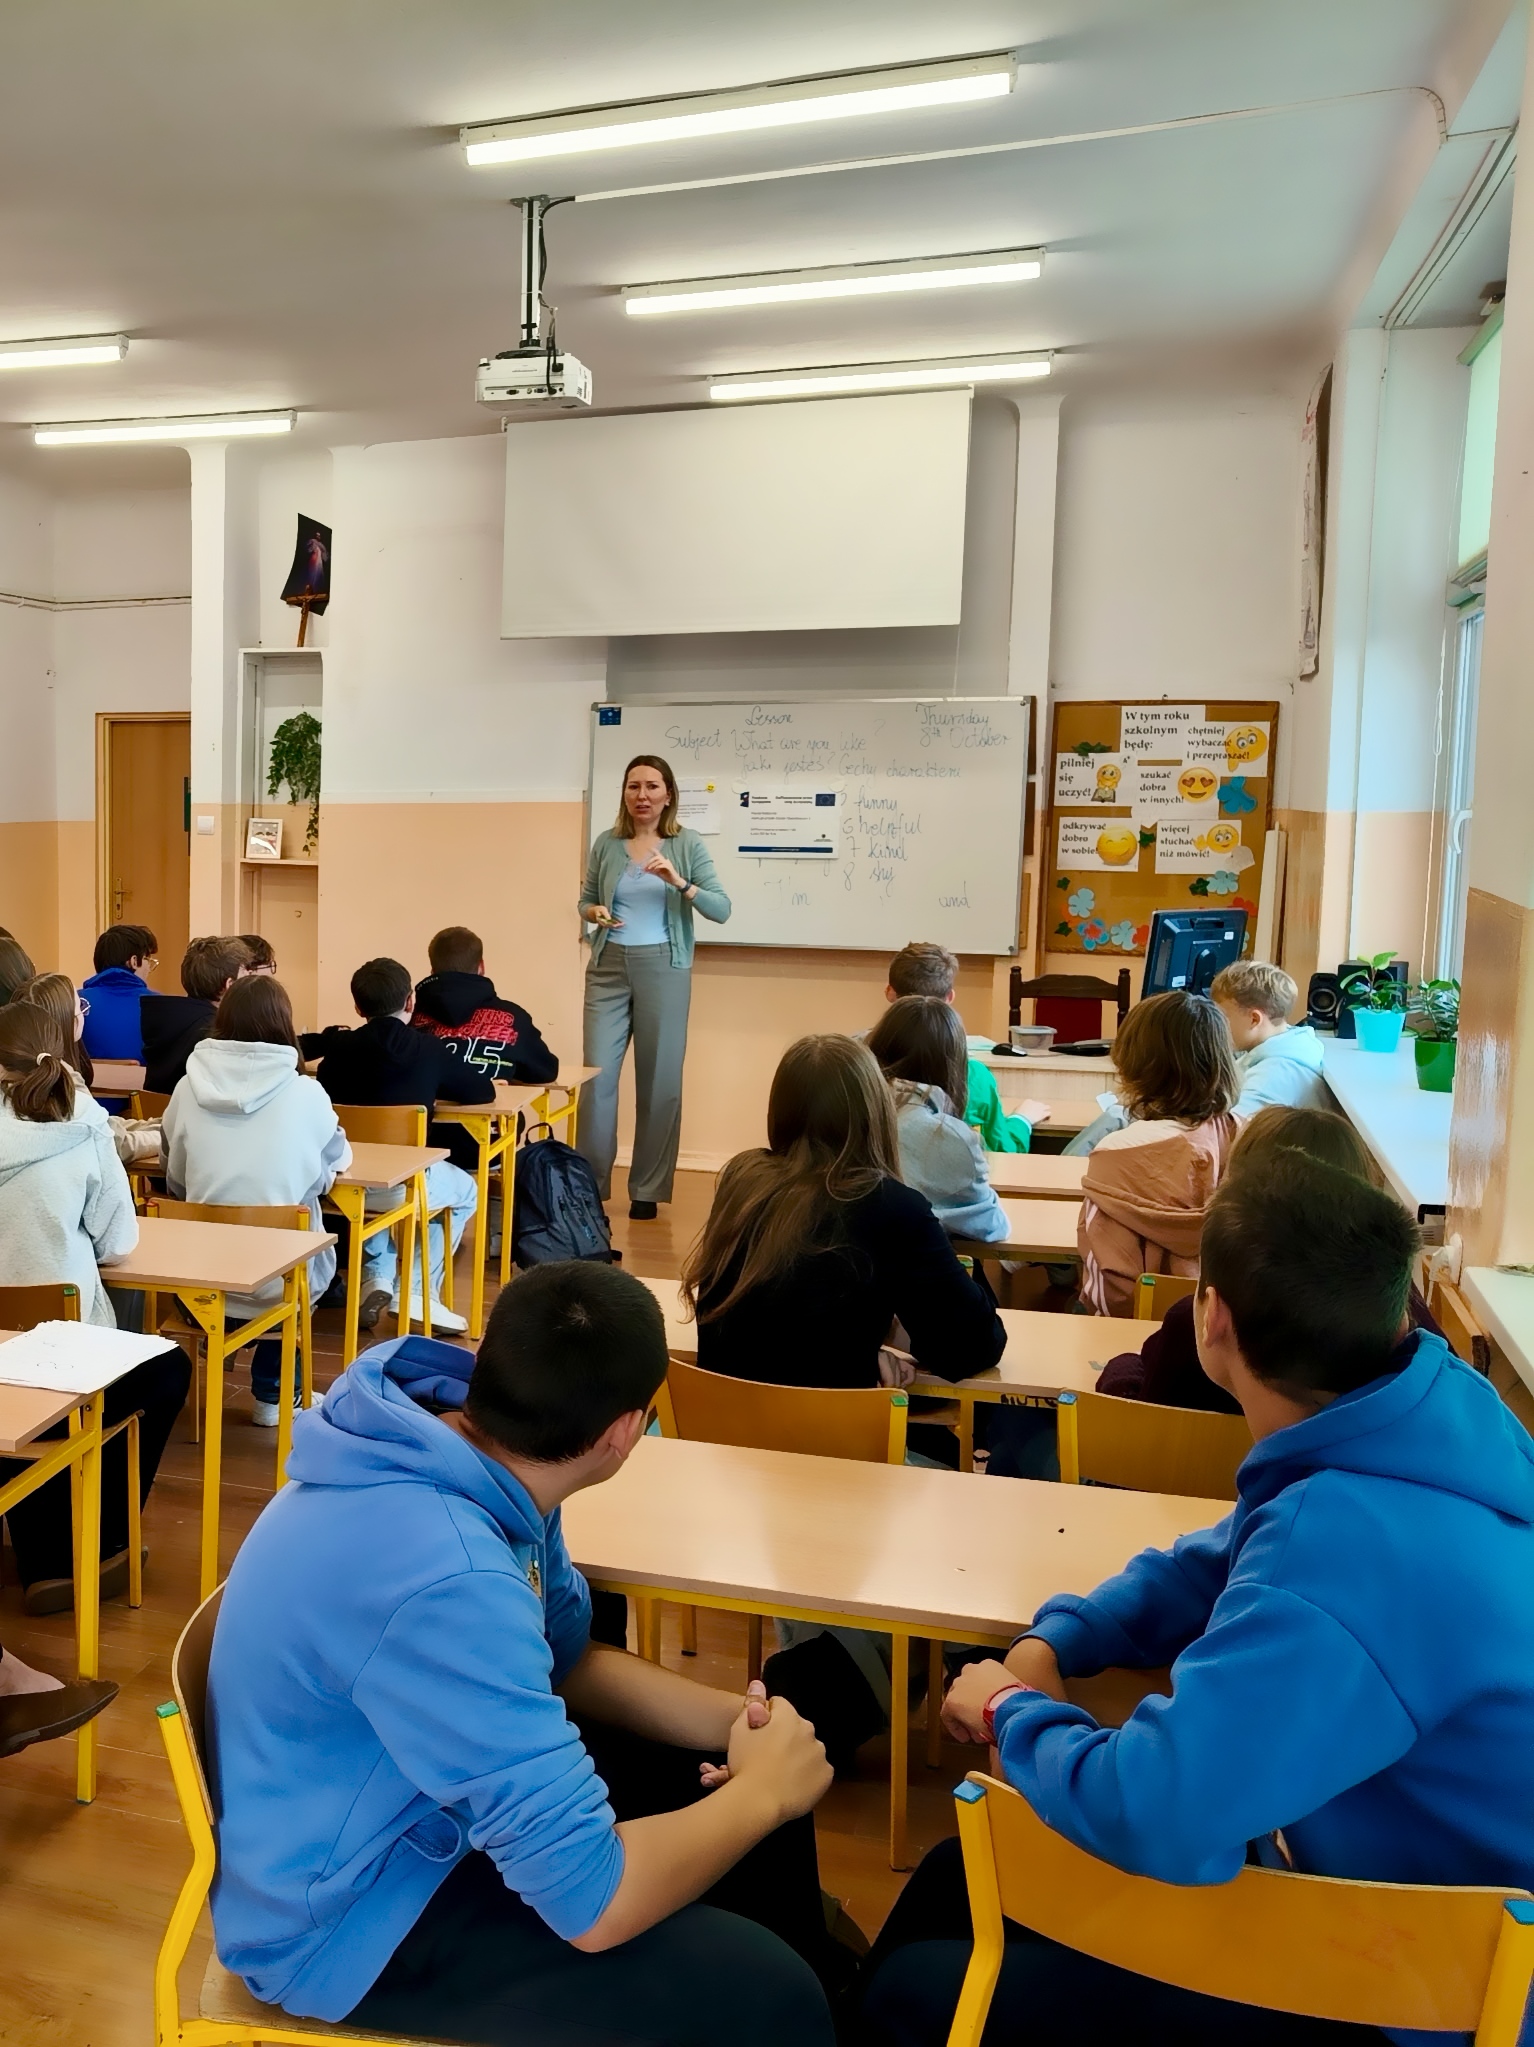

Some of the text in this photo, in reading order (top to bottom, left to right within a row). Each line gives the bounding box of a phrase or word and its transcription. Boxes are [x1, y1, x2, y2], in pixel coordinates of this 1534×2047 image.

[745, 705, 794, 726] Lesson
[915, 703, 991, 727] Thursday
[1125, 711, 1190, 724] W tym roku
[1124, 725, 1178, 737] szkolnym
[1187, 726, 1226, 737] chętniej
[664, 725, 722, 761] Subject
[730, 728, 774, 752] What
[779, 738, 801, 751] are
[806, 739, 831, 757] you
[839, 731, 867, 751] like
[919, 726, 1012, 750] 8th October
[1187, 738, 1231, 749] wybaczać
[1124, 739, 1153, 752] będę:
[1192, 750, 1250, 762] przepraszać!
[735, 752, 773, 780] Jaki
[839, 753, 879, 783] Cechy
[886, 758, 962, 779] charakteru
[1060, 757, 1095, 769] pilniej
[1058, 773, 1074, 784] się
[1140, 770, 1172, 779] szukać
[1058, 787, 1092, 799] uczyć!
[1139, 783, 1167, 792] dobra
[853, 785, 898, 815] funny
[1150, 795, 1184, 806] innych!
[858, 812, 923, 840] helpful
[1062, 821, 1107, 832] odkrywać
[1160, 824, 1190, 834] więcej
[1061, 834, 1089, 842] dobro
[1160, 835, 1195, 845] słuchać
[846, 836, 908, 862] 7 kind
[1071, 847, 1099, 855] sobie!
[1159, 849, 1210, 858] niż mówić!
[843, 860, 897, 899] 8 shy
[938, 880, 971, 909] and
